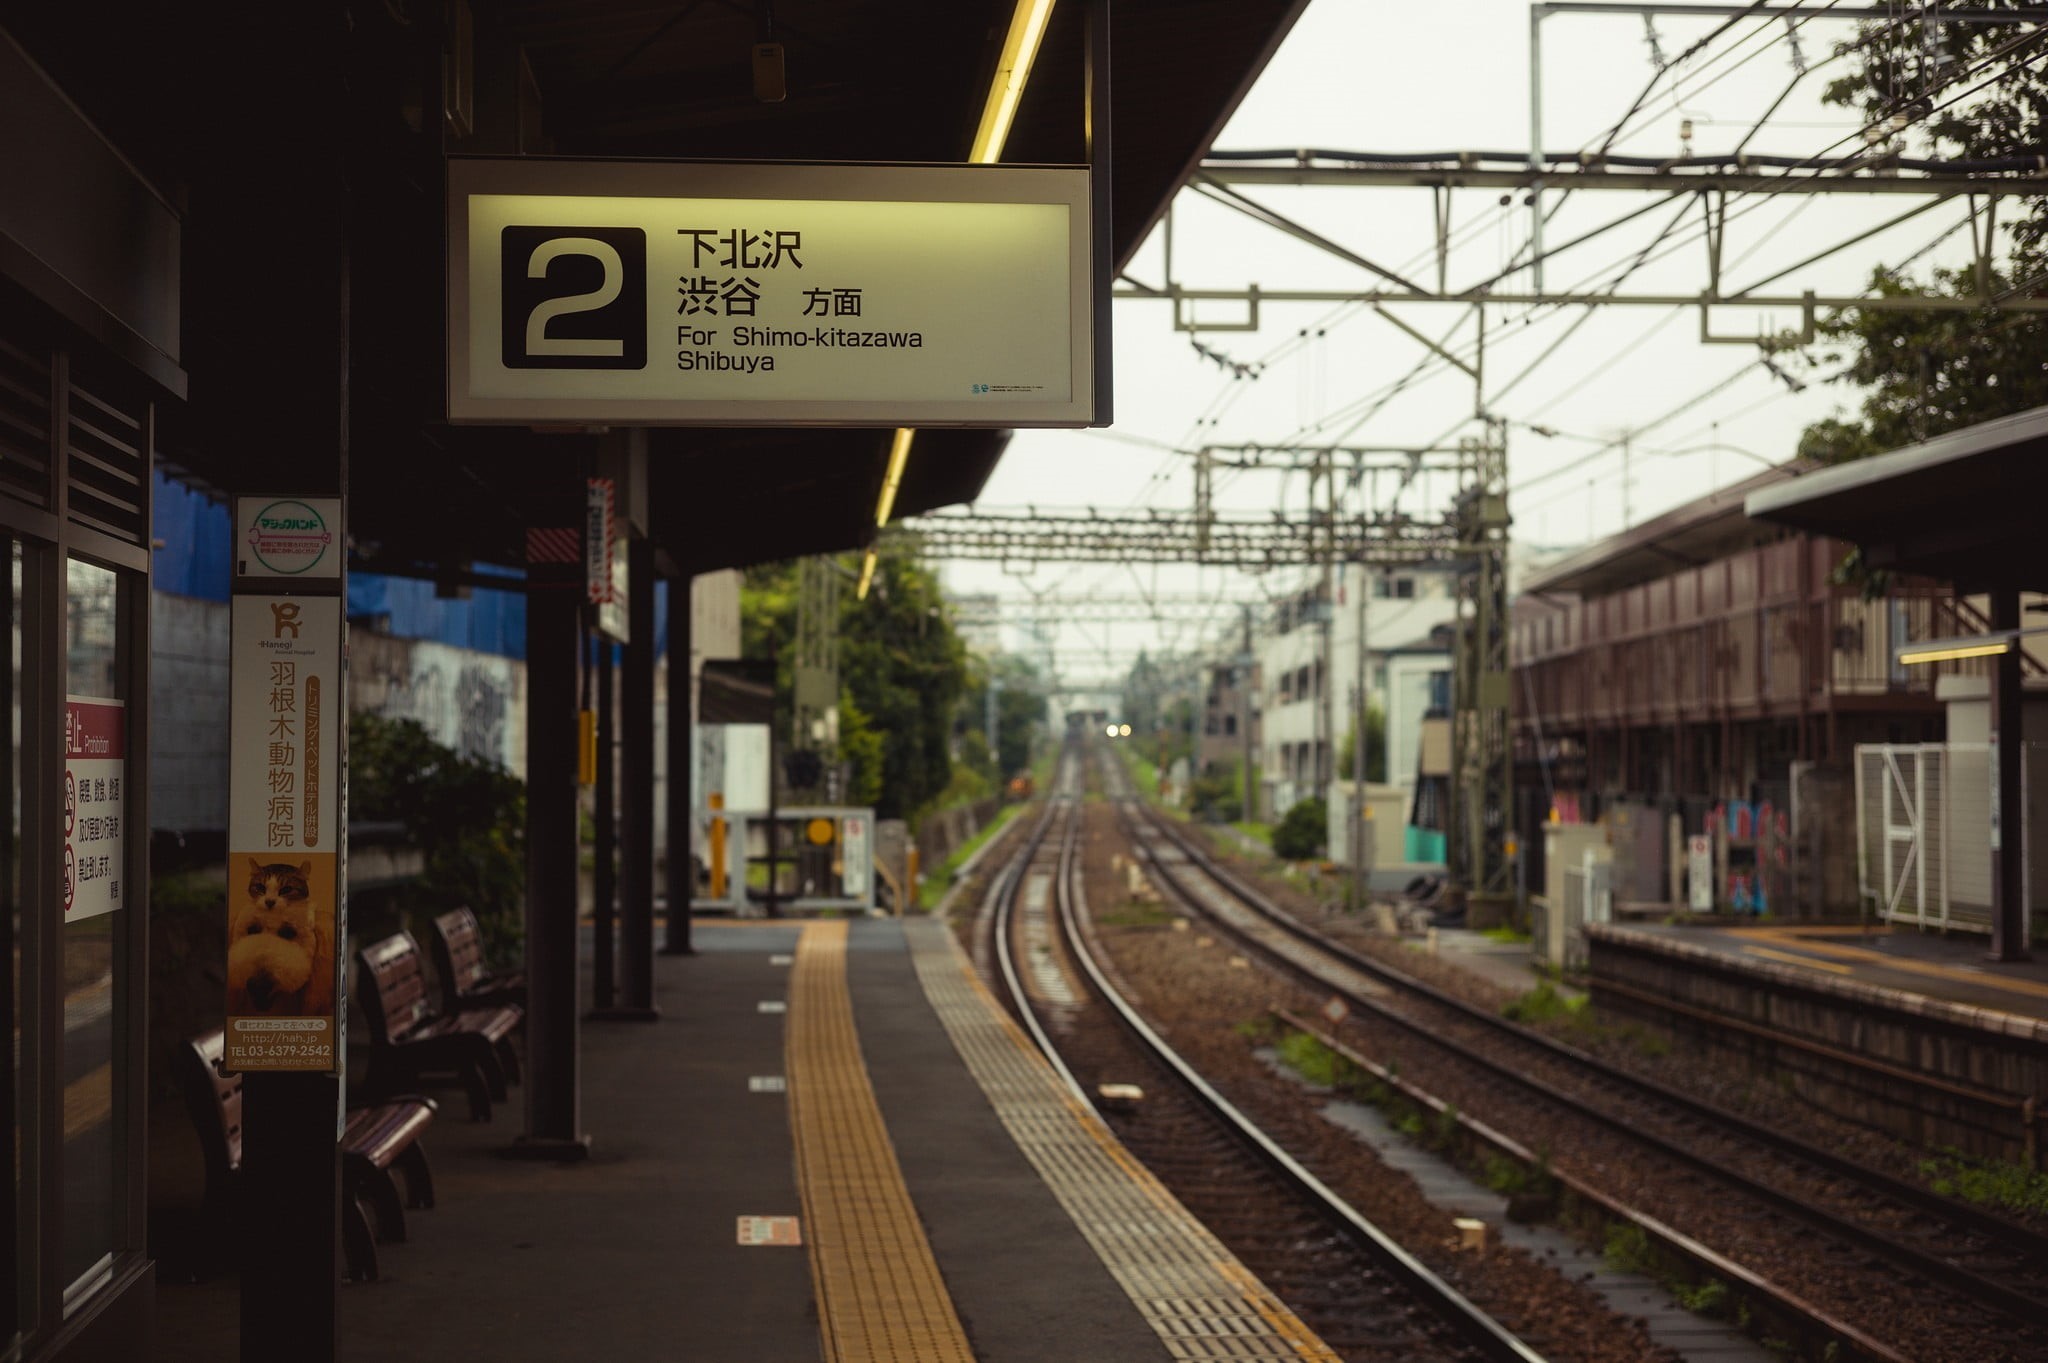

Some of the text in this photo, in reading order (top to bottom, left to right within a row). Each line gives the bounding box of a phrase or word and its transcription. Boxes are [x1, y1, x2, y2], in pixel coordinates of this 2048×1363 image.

[677, 229, 803, 270] 下北沢
[525, 237, 624, 357] 2
[677, 276, 862, 317] 渋谷 方面
[677, 326, 923, 350] For Shimo-kitazawa
[677, 351, 775, 373] Shibuya
[261, 518, 318, 530] マジックハンド
[84, 735, 110, 754] Prohibition
[268, 661, 296, 848] 羽根木動物病院
[242, 1033, 318, 1044] http://hah.jp
[231, 1045, 331, 1056] TEL 03-6379-2542
